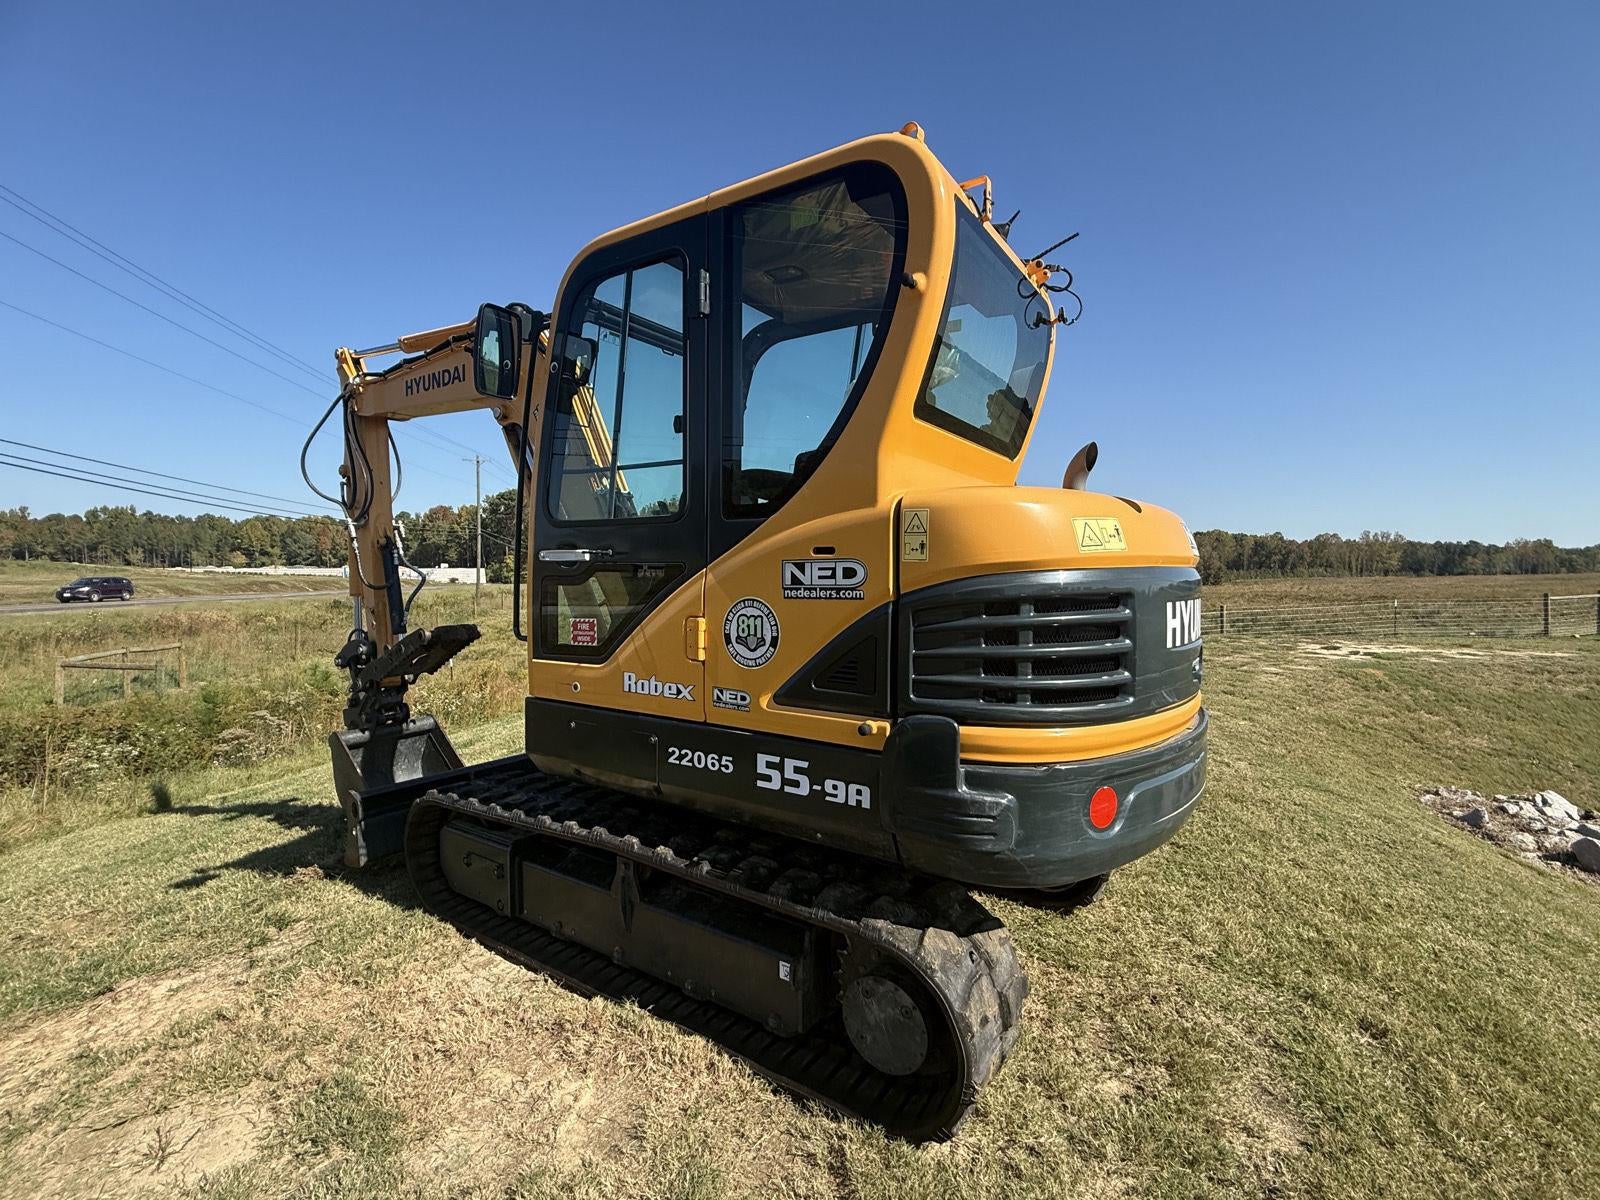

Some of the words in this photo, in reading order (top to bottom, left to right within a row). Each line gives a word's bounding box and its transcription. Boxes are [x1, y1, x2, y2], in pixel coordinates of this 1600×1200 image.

[405, 364, 465, 397] HYUNDAI
[785, 561, 865, 585] NED
[784, 587, 864, 598] nedealers.com
[738, 615, 762, 638] 811
[623, 671, 696, 701] Robex
[713, 688, 751, 705] NED
[713, 701, 750, 711] nedealers.com
[667, 747, 734, 774] 22065
